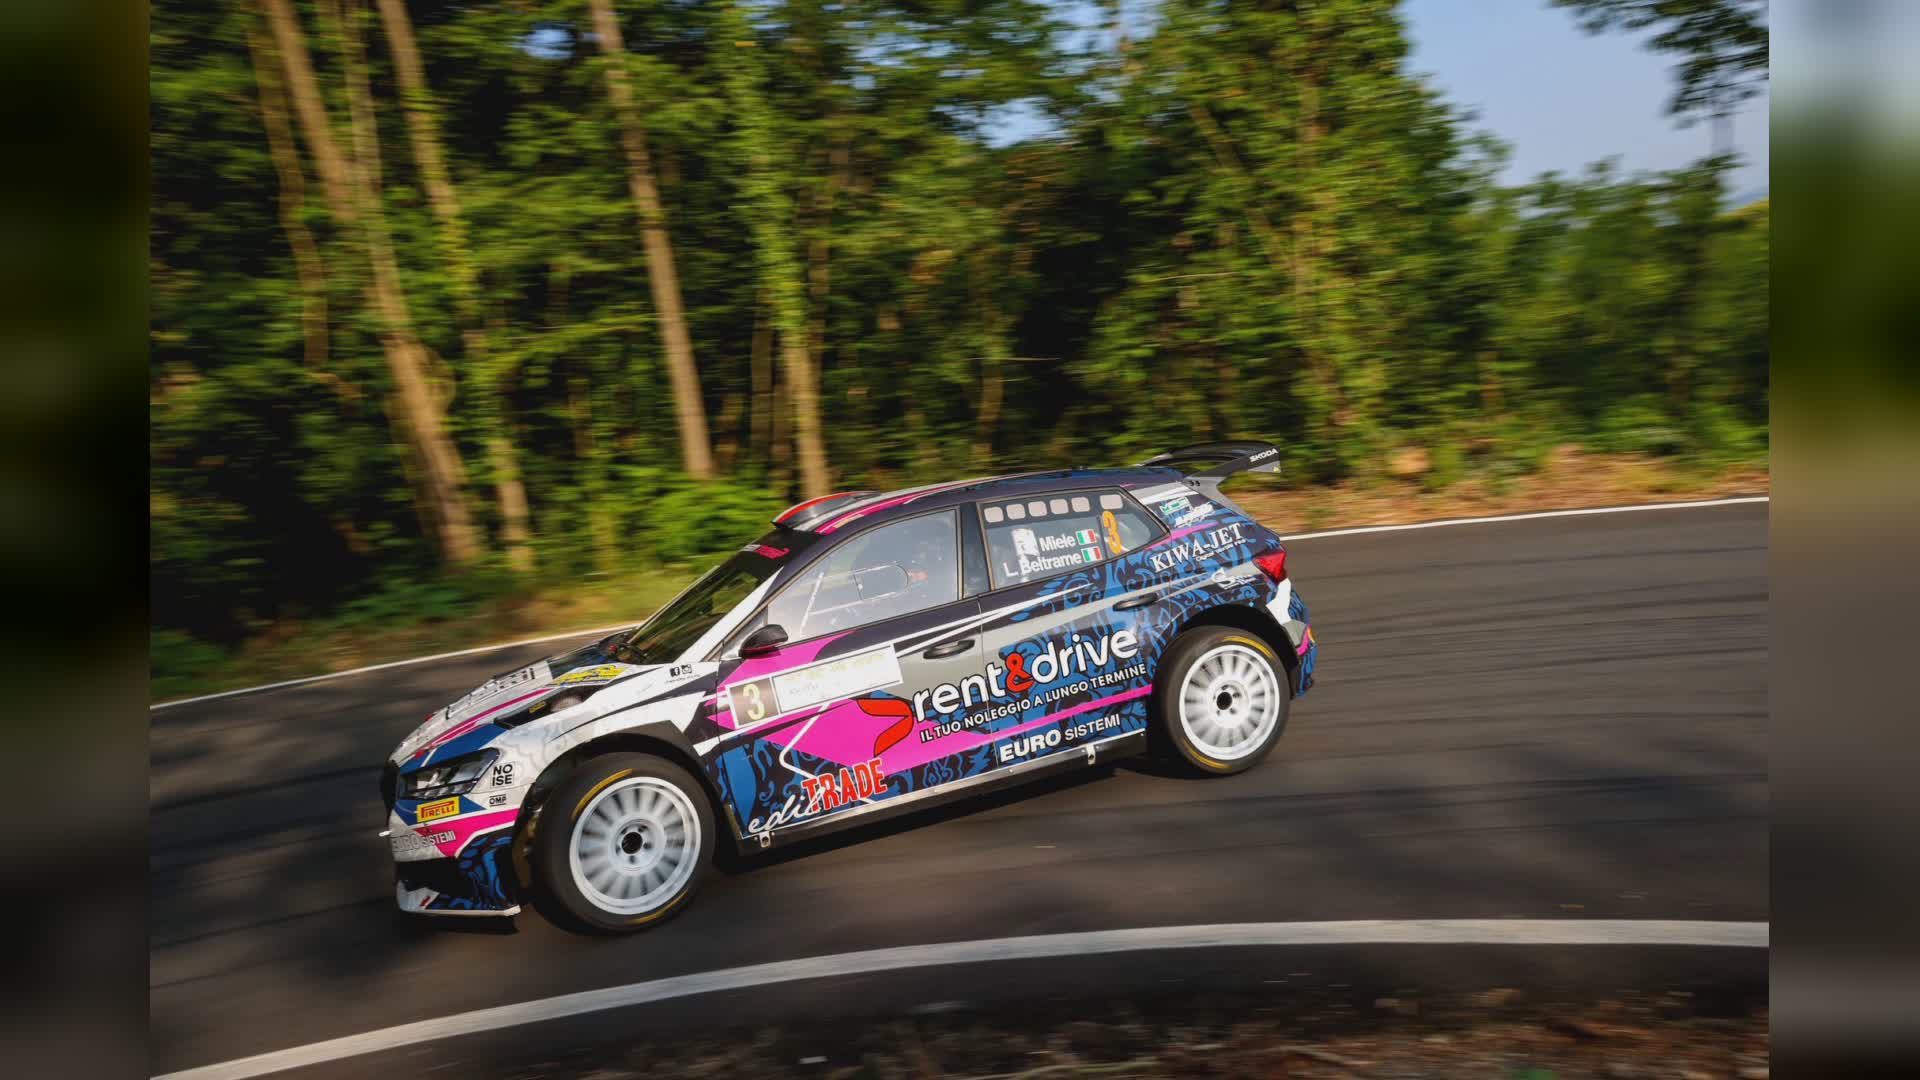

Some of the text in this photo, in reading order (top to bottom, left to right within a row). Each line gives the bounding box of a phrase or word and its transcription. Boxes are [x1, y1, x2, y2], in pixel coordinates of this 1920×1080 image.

[1039, 533, 1077, 552] Miele
[1101, 510, 1122, 555] 3
[1150, 522, 1244, 573] KIWA-JET
[1018, 551, 1082, 578] Beltrame
[912, 629, 1138, 722] rent&drive
[742, 683, 766, 721] 3
[920, 664, 1147, 743] IL TUO NOLEGGIO A LUNGO TERMINE
[1000, 713, 1121, 762] EURO SISTEMI
[492, 775, 513, 787] ISE
[493, 763, 513, 775] NO
[801, 757, 888, 812] TRADE
[421, 800, 456, 819] PIRELLI
[488, 796, 507, 805] OMP
[421, 830, 457, 848] SISTEMI
